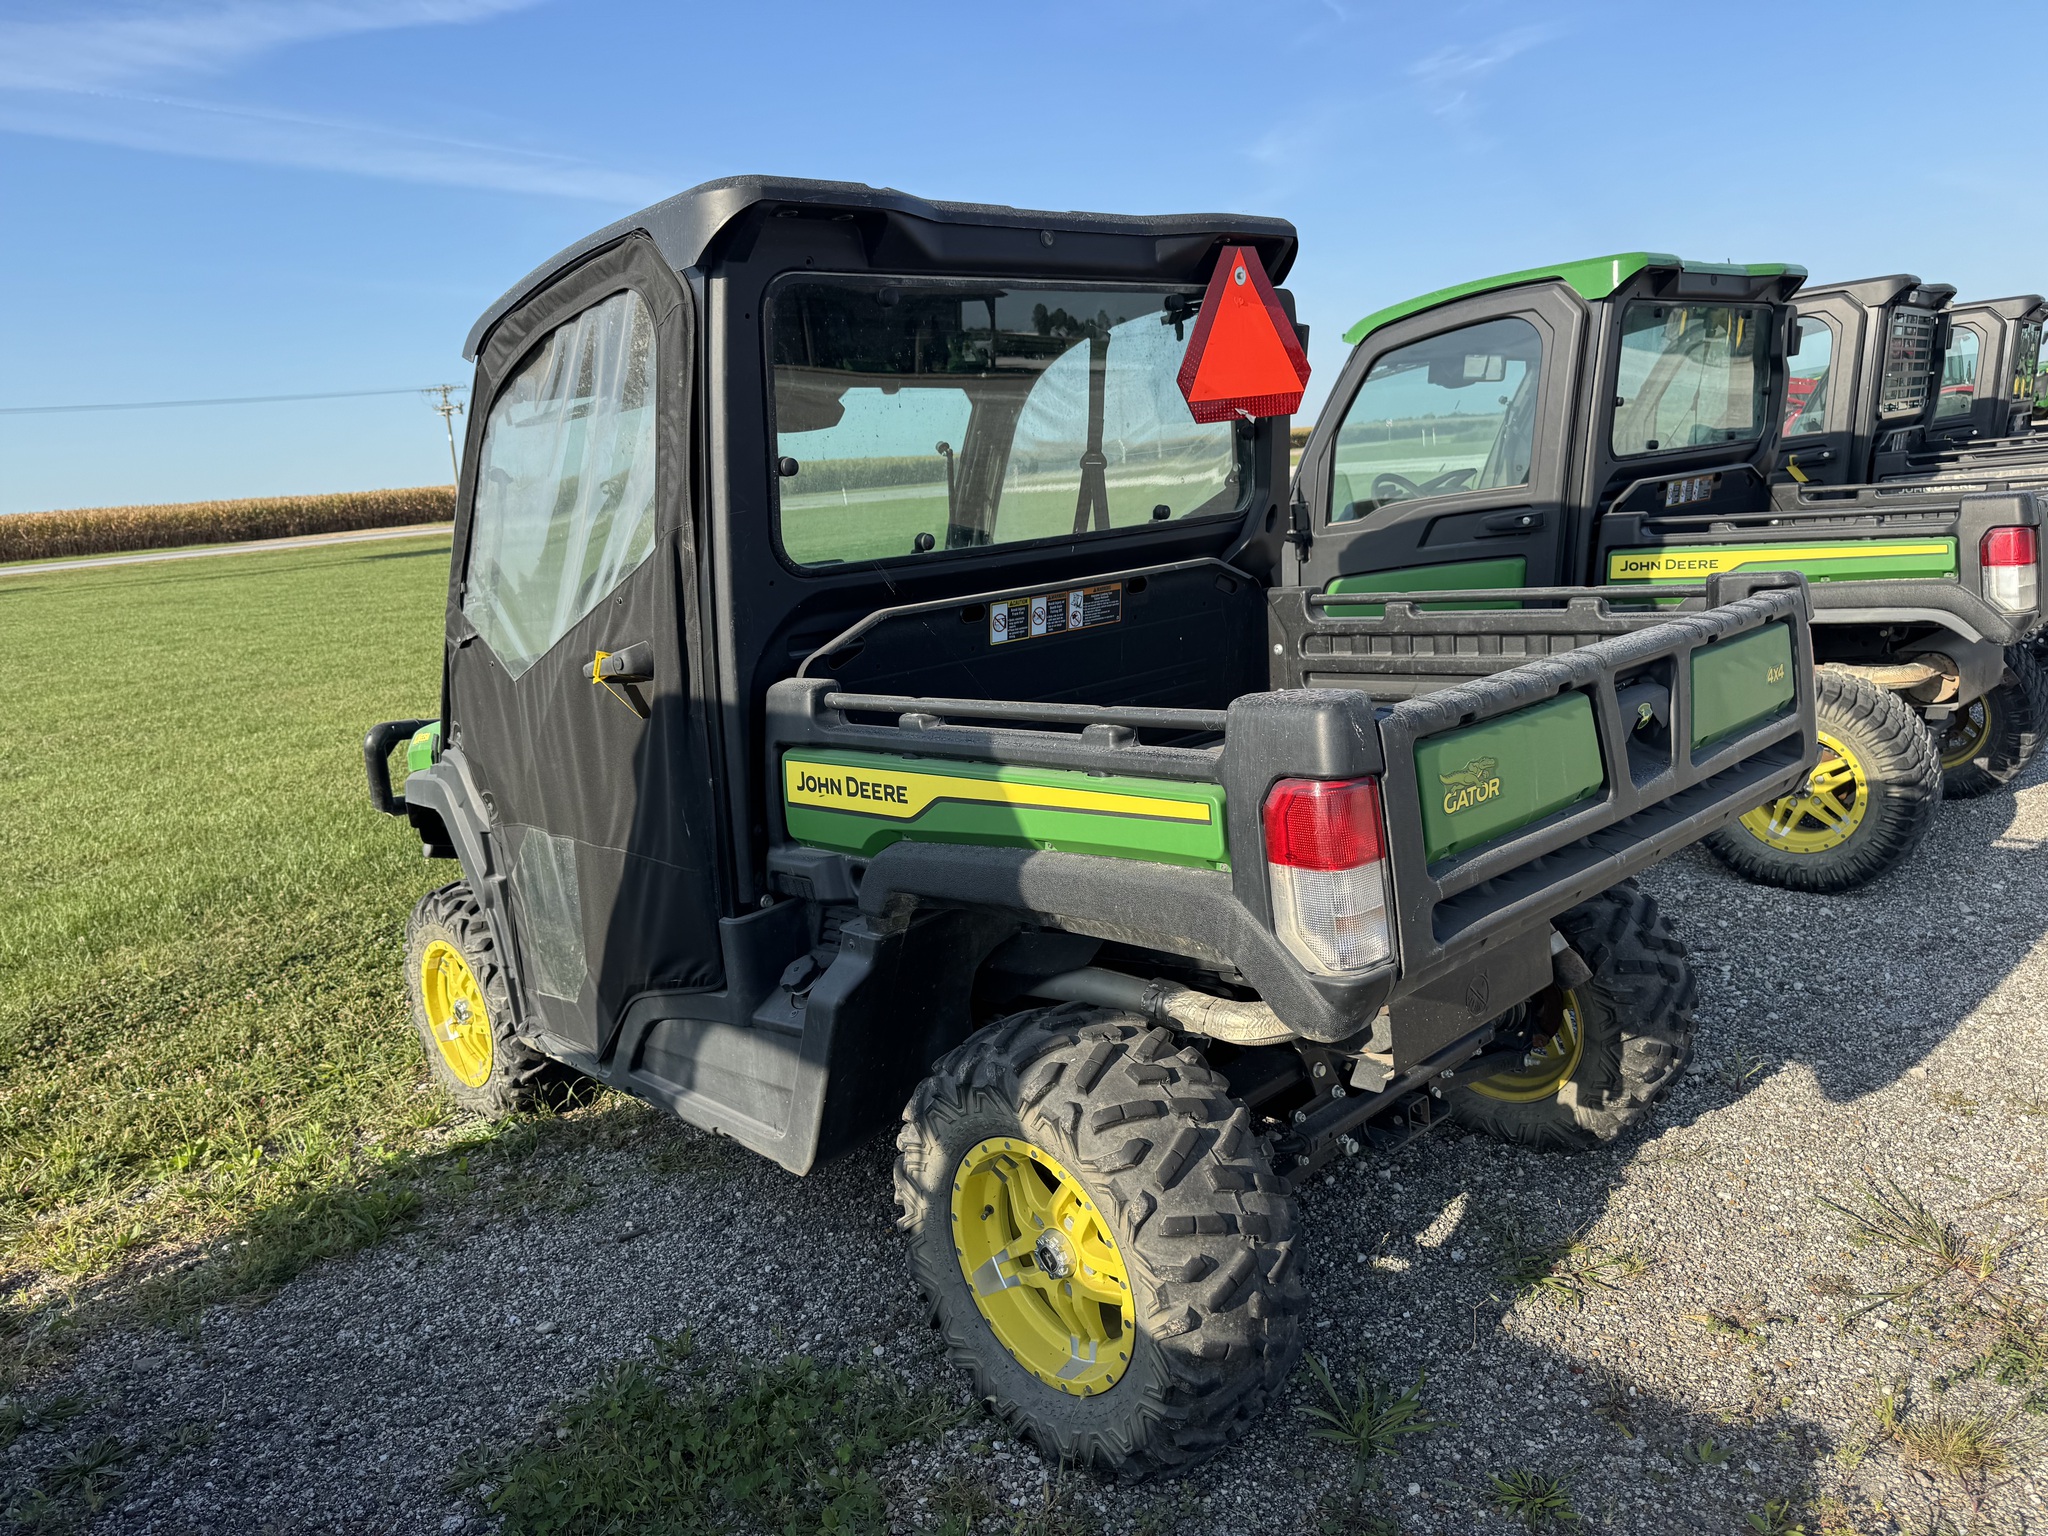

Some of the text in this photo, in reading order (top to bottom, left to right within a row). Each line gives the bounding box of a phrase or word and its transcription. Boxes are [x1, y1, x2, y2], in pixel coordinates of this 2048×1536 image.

[1620, 559, 1719, 572] JOHN DEERE
[796, 771, 909, 804] JOHN DEERE
[1443, 777, 1500, 814] GATOR
